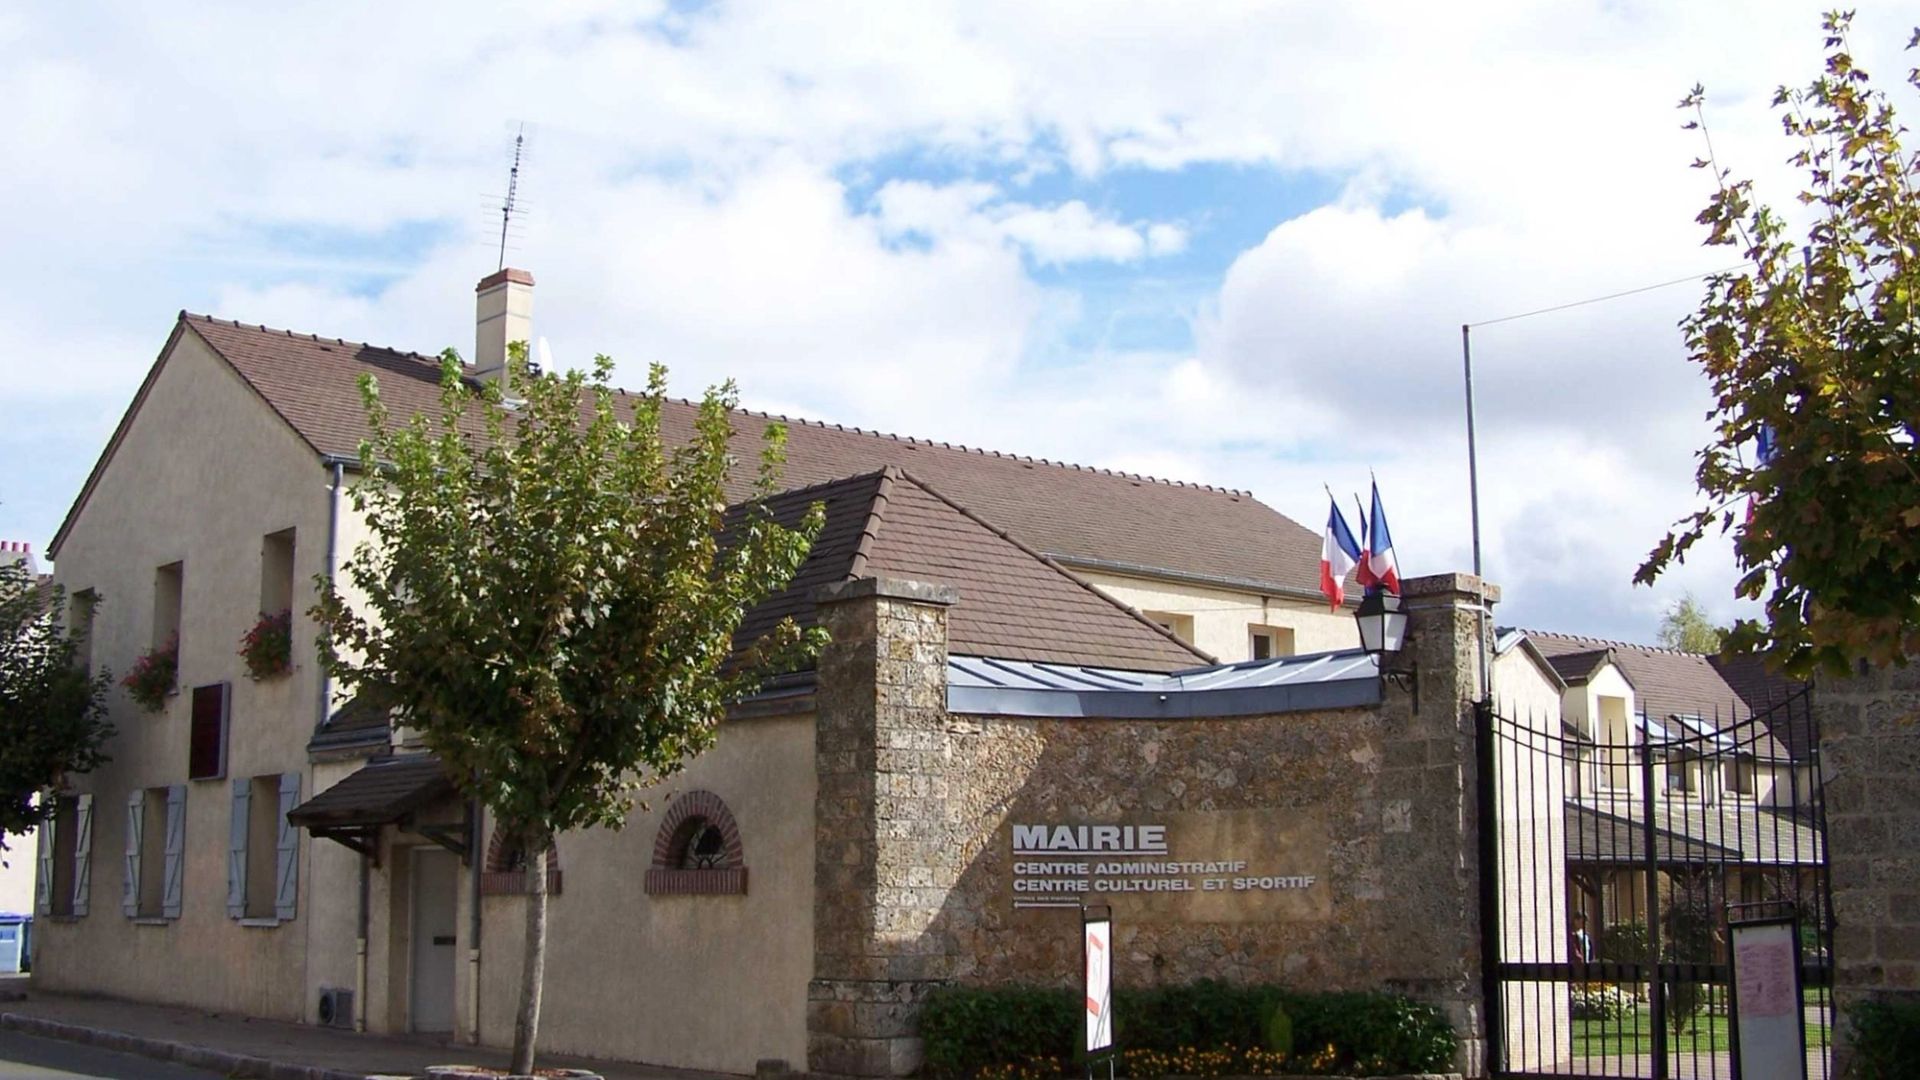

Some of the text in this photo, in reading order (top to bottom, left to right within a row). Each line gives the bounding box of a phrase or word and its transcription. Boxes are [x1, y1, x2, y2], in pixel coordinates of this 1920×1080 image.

[1013, 825, 1167, 850] MAIRIE
[1013, 861, 1246, 875] CENTRE ADMINISTRATIF
[1013, 876, 1316, 892] CENTRE CULTUREL ET SPORTIF
